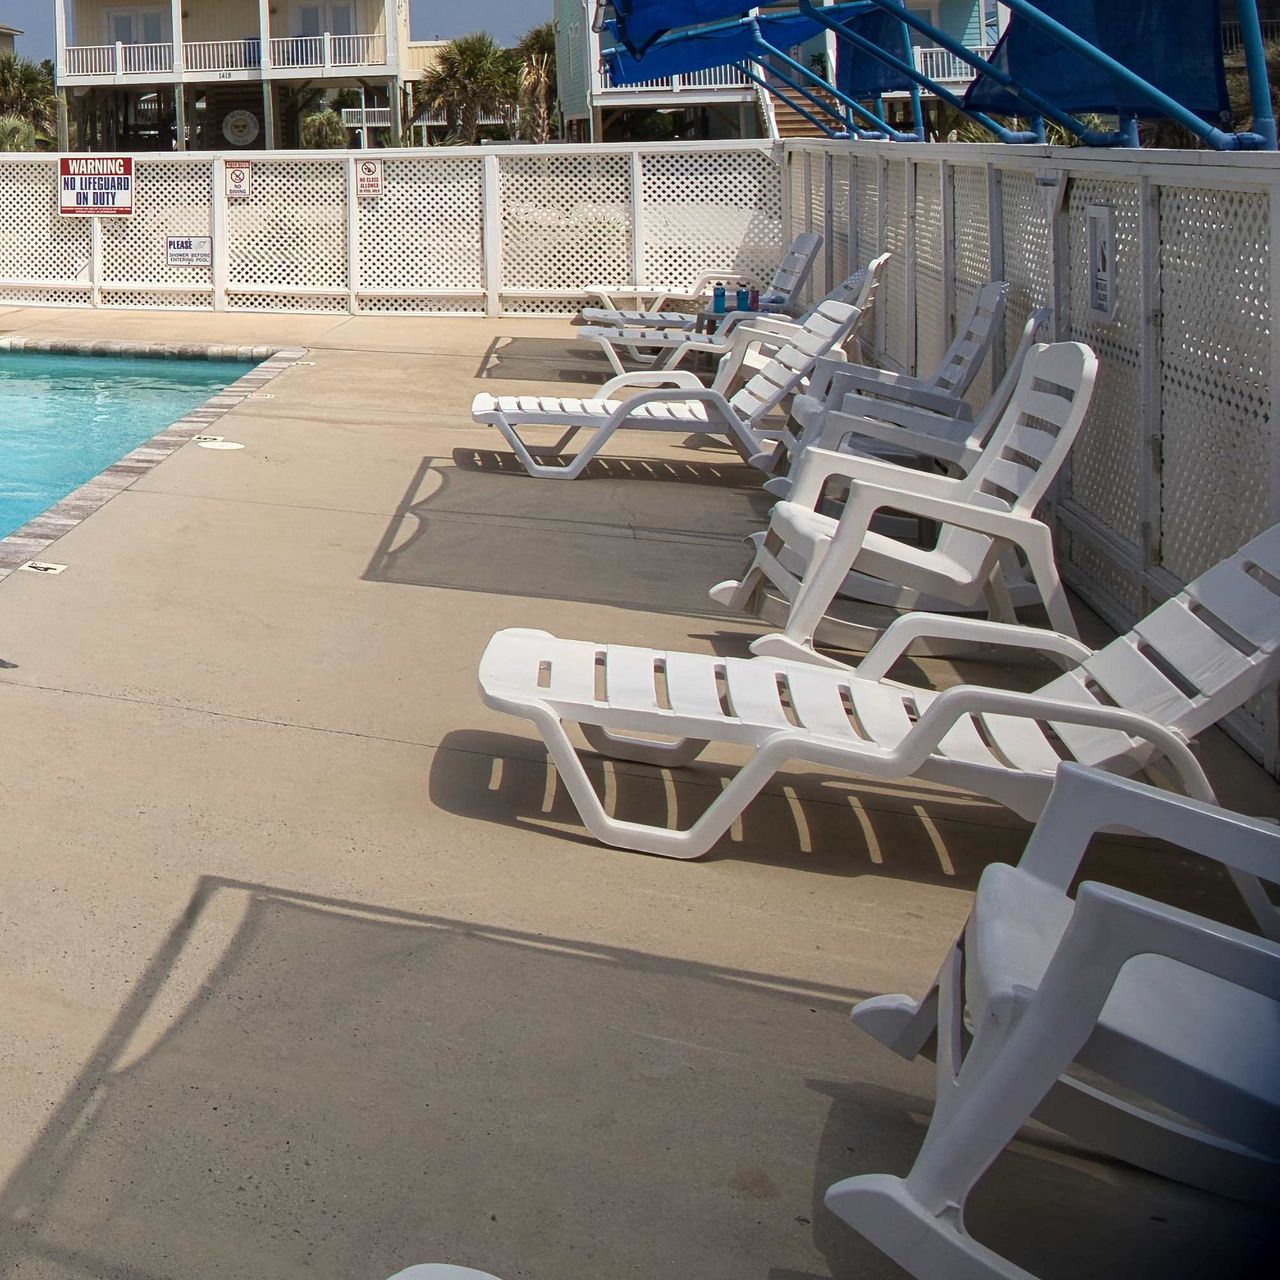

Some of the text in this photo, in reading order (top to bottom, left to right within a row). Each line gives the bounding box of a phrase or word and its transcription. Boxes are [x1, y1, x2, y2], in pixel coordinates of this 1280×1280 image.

[68, 159, 124, 174] WARNING
[63, 176, 130, 191] NO LIFEGUARD
[76, 191, 117, 206] ON DUTY
[168, 240, 193, 250] PLEASE
